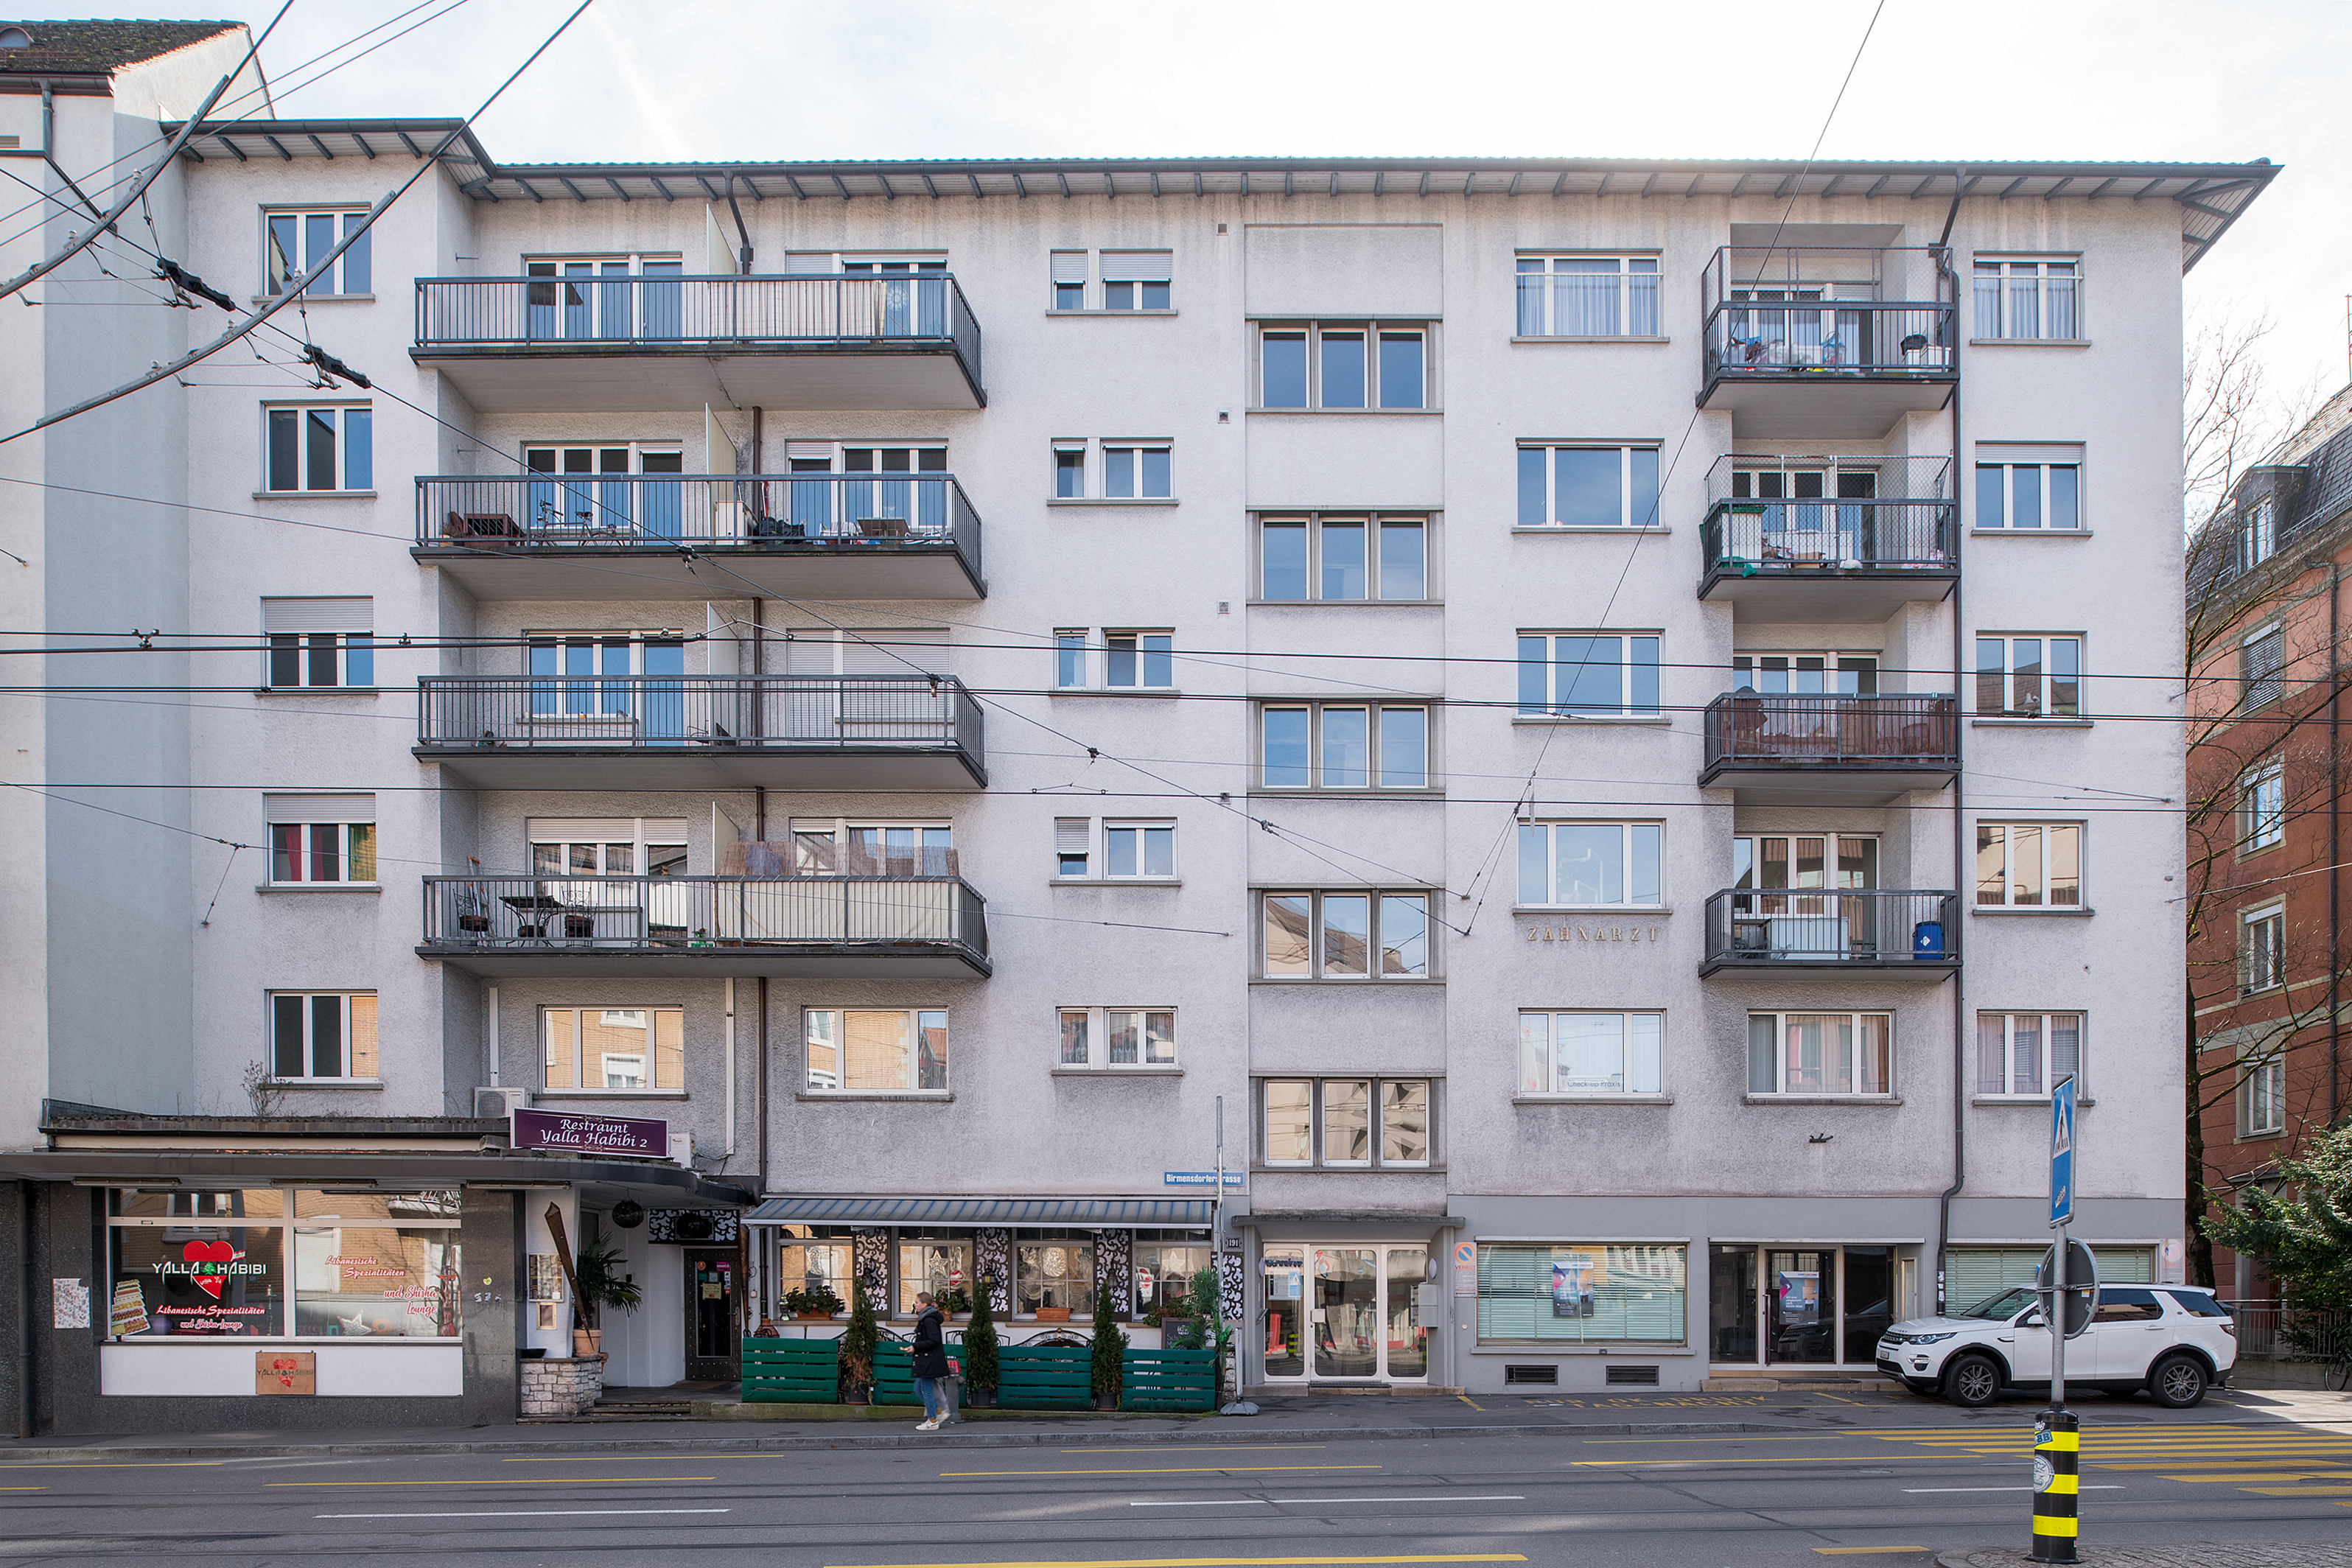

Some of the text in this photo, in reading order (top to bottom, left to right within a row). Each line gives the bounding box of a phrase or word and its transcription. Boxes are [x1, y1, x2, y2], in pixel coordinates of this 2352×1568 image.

[1527, 927, 1658, 941] ZAHNARZT
[1567, 1080, 1599, 1088] Check-up
[560, 1119, 629, 1133] Restraunt
[540, 1129, 648, 1148] Yalla Habibi 2
[1166, 1174, 1242, 1183] Birmensdorfersrasse
[1228, 1239, 1239, 1247] 191
[325, 1255, 378, 1265] Libanesische
[152, 1261, 267, 1284] YALLA HABIBI
[343, 1267, 405, 1279] Spezialitäten
[384, 1284, 438, 1299] und Shisha
[155, 1304, 266, 1317] Libanesische Spezialitäten
[406, 1301, 438, 1317] Lounge
[180, 1318, 195, 1329] und
[257, 1368, 280, 1380] YALLA
